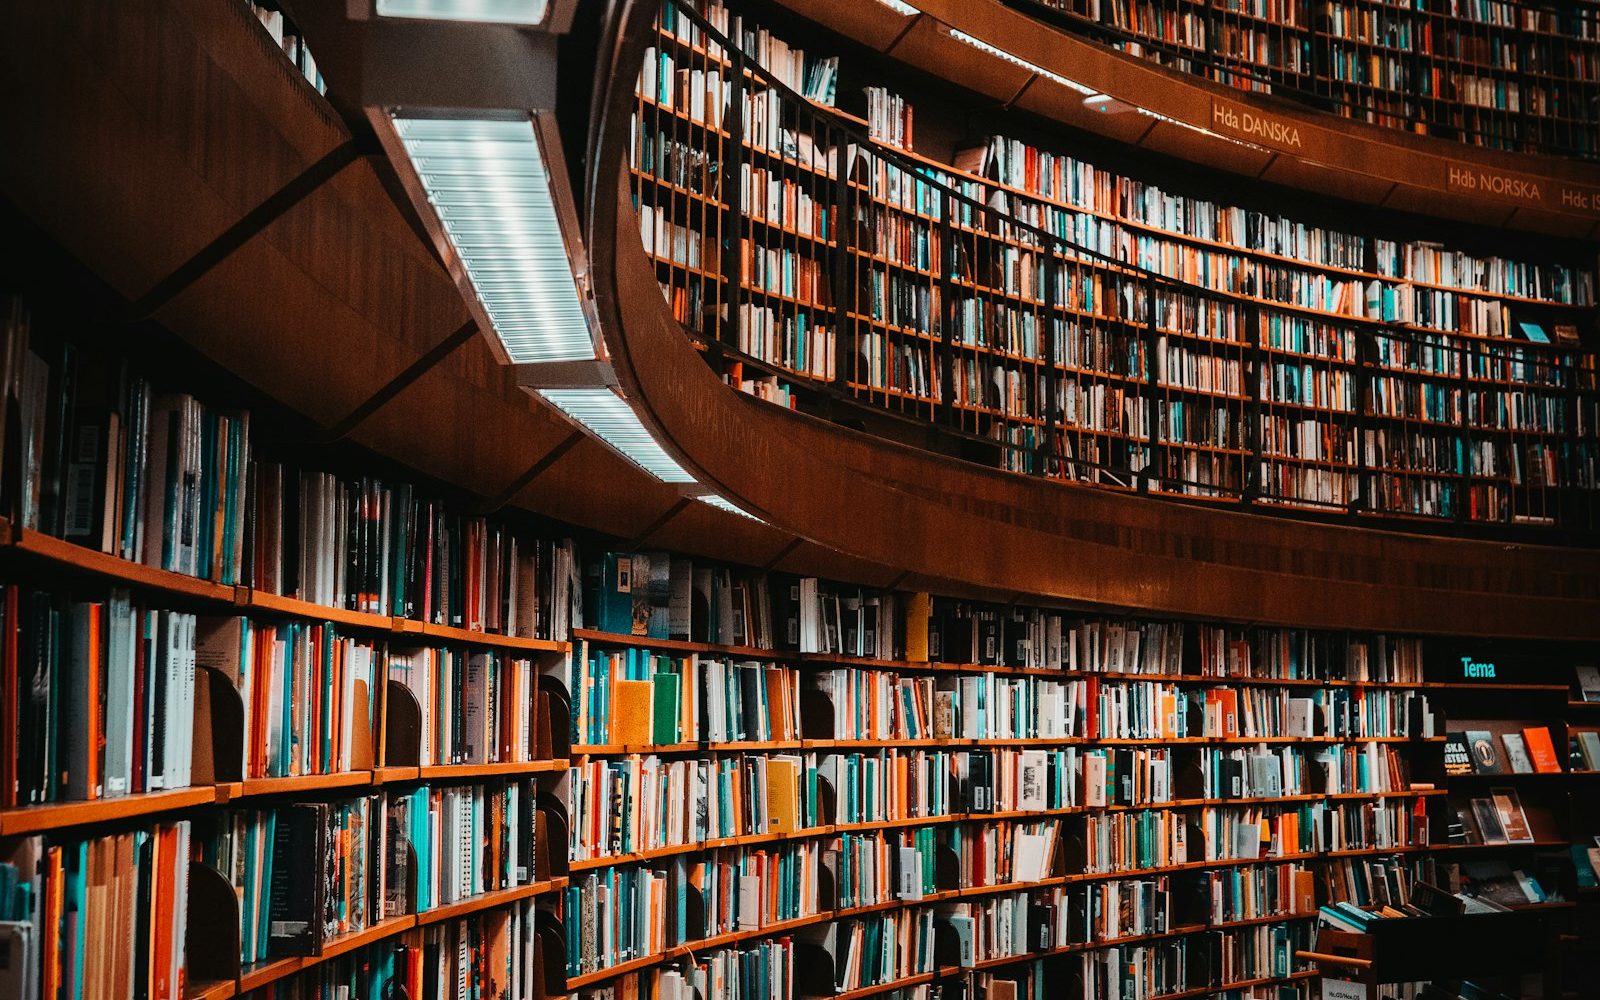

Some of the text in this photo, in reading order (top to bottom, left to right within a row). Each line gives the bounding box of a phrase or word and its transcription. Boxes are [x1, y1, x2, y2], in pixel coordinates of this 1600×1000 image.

[1214, 104, 1301, 147] Hda DANSKA
[1449, 168, 1541, 199] Hdb NORSKA
[1561, 189, 1588, 208] Hdc
[1461, 656, 1496, 678] Tema
[1444, 742, 1466, 753] SKA
